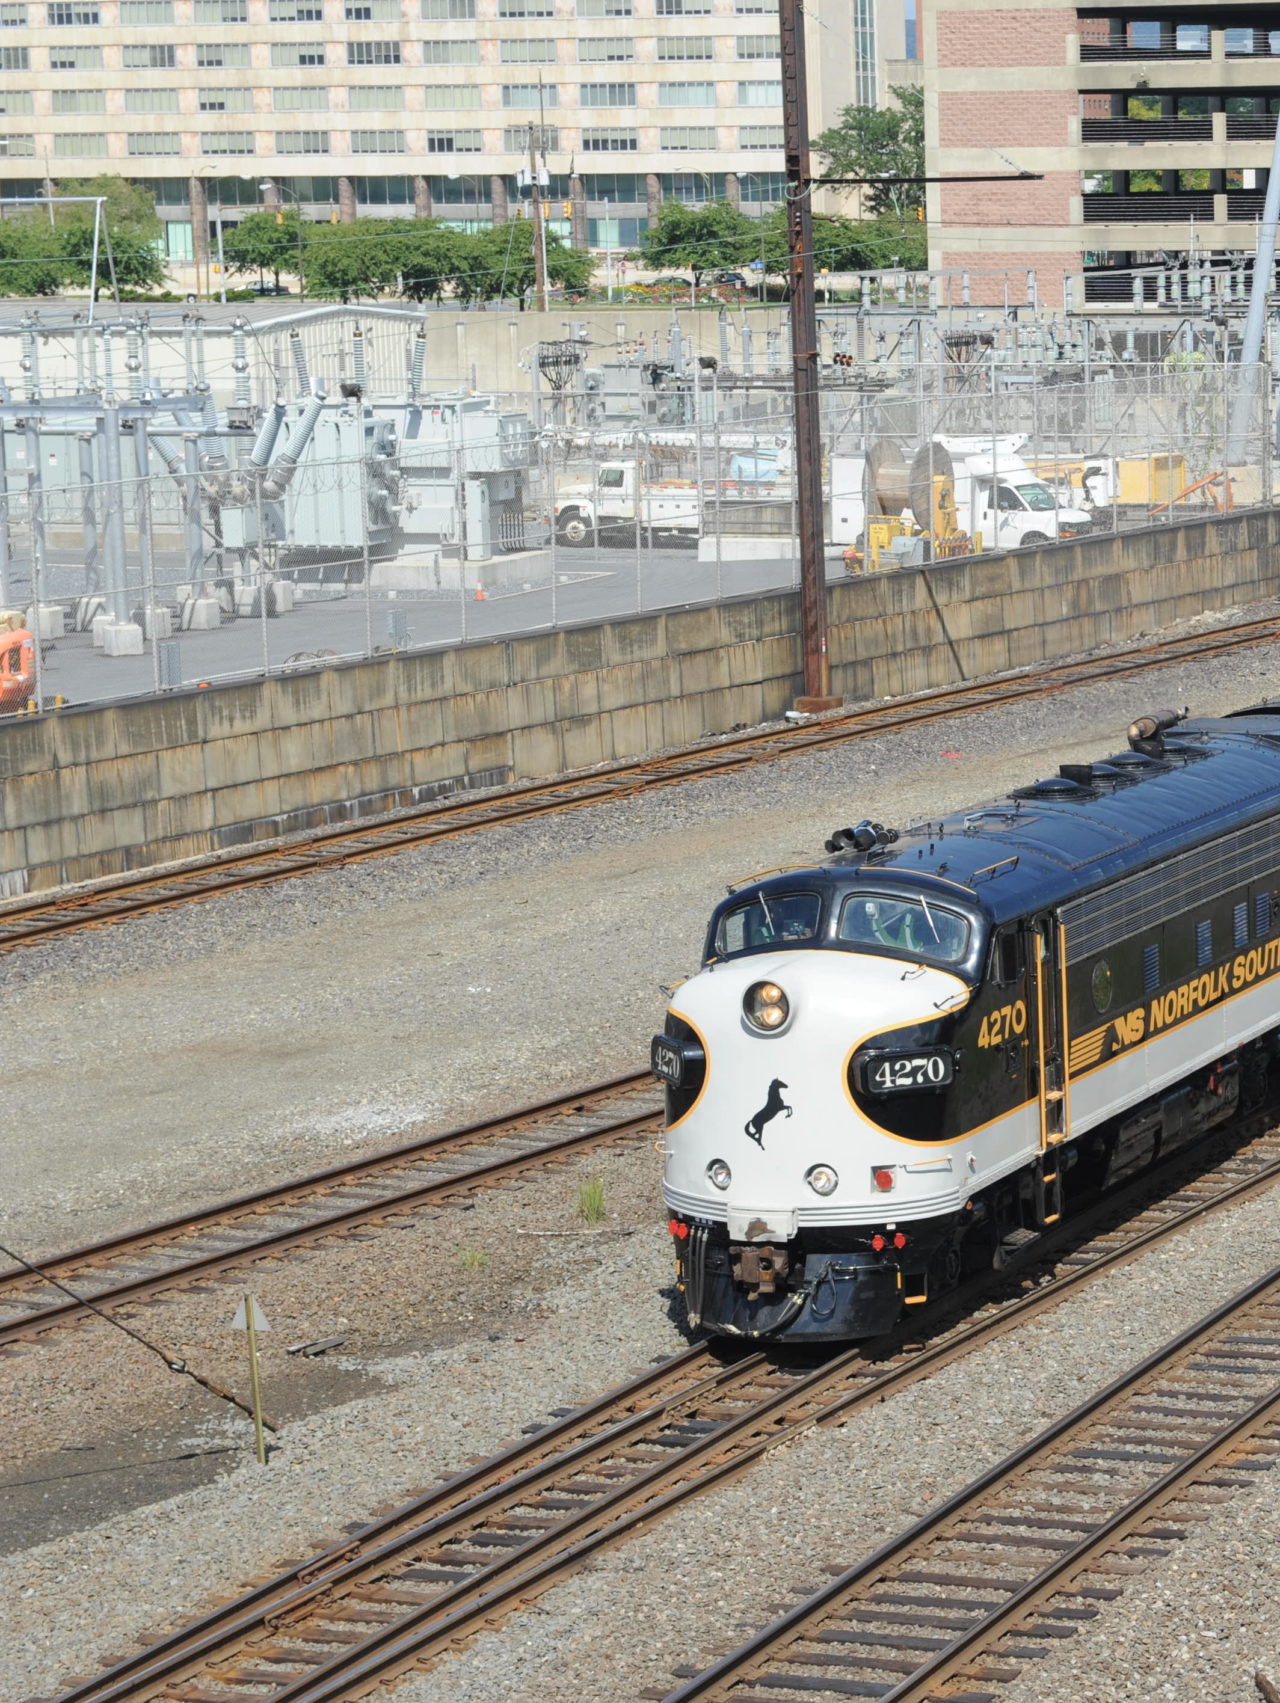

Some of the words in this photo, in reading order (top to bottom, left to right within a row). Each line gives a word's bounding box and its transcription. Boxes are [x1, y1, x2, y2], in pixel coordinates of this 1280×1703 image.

[977, 999, 1027, 1049] 4270
[1112, 1007, 1146, 1051] NS
[1149, 962, 1231, 1033] NORFOLK
[654, 1045, 680, 1080] 4270
[874, 1056, 945, 1088] 4270
